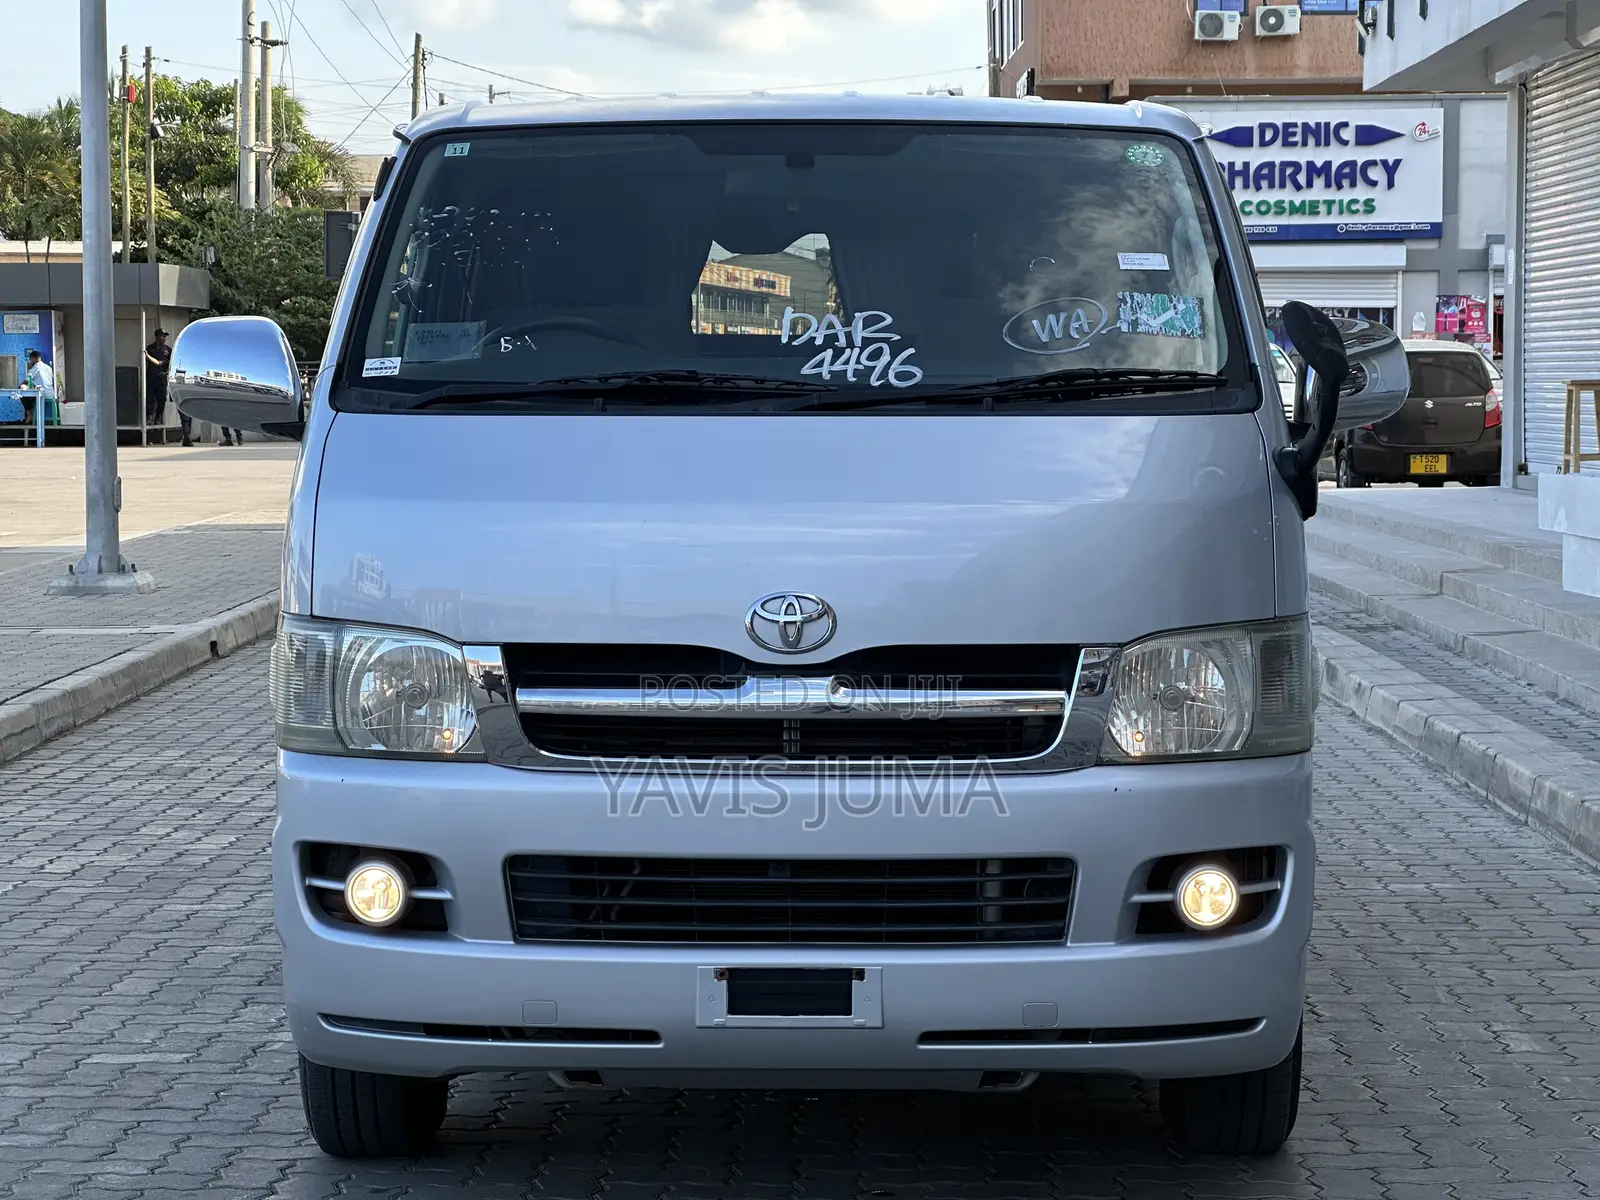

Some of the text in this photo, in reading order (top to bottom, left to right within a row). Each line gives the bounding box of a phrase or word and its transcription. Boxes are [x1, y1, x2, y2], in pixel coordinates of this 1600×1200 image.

[1257, 121, 1350, 147] DENIC
[1218, 158, 1402, 192] HARMACY
[1239, 197, 1376, 216] COSMETICS
[781, 306, 901, 347] DAR
[1032, 308, 1094, 342] WA
[800, 342, 924, 388] 4496
[1424, 464, 1440, 473] EEL
